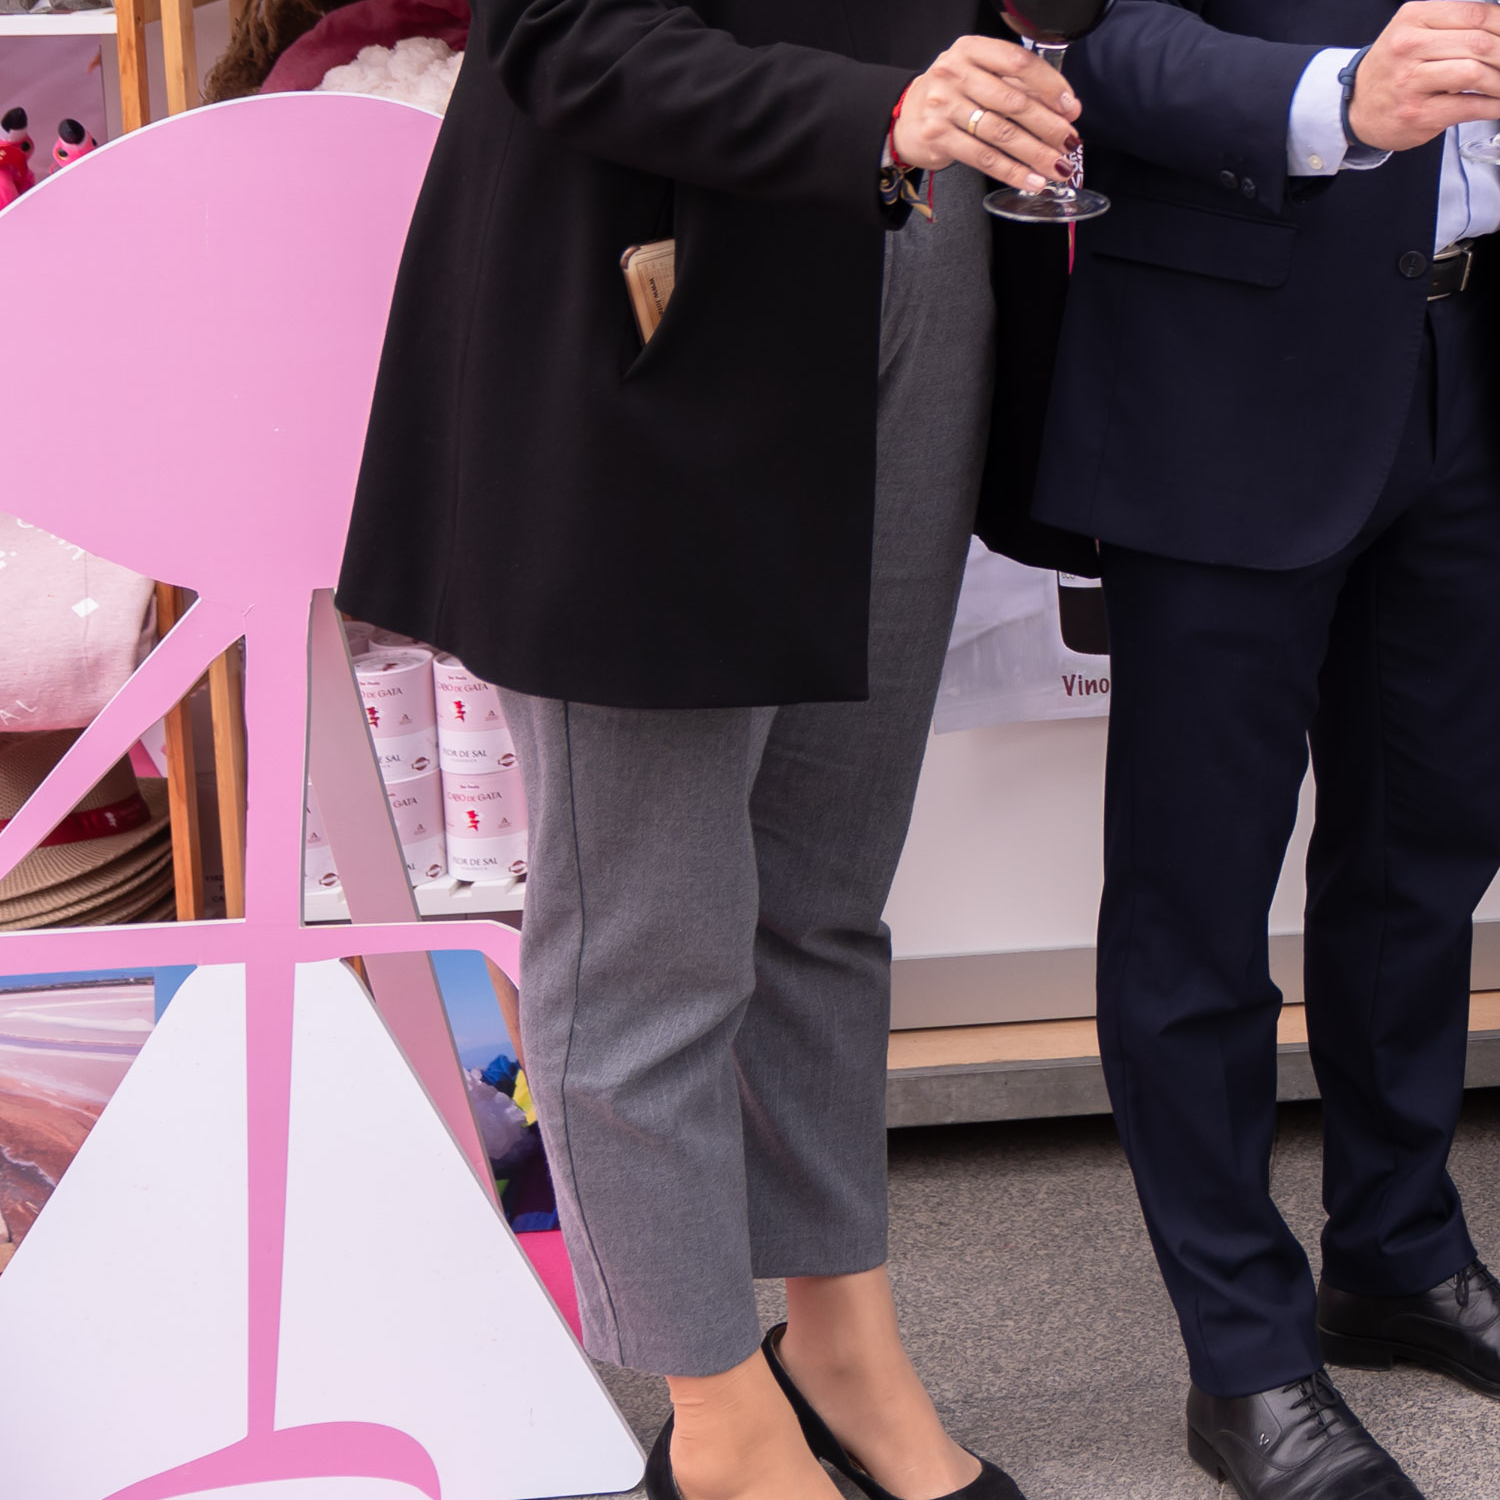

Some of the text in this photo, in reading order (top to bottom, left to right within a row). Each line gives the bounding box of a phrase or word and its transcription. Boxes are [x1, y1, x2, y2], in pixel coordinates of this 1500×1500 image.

[464, 683, 488, 692] GATA
[1061, 674, 1110, 697] Vino
[478, 792, 502, 802] GATA
